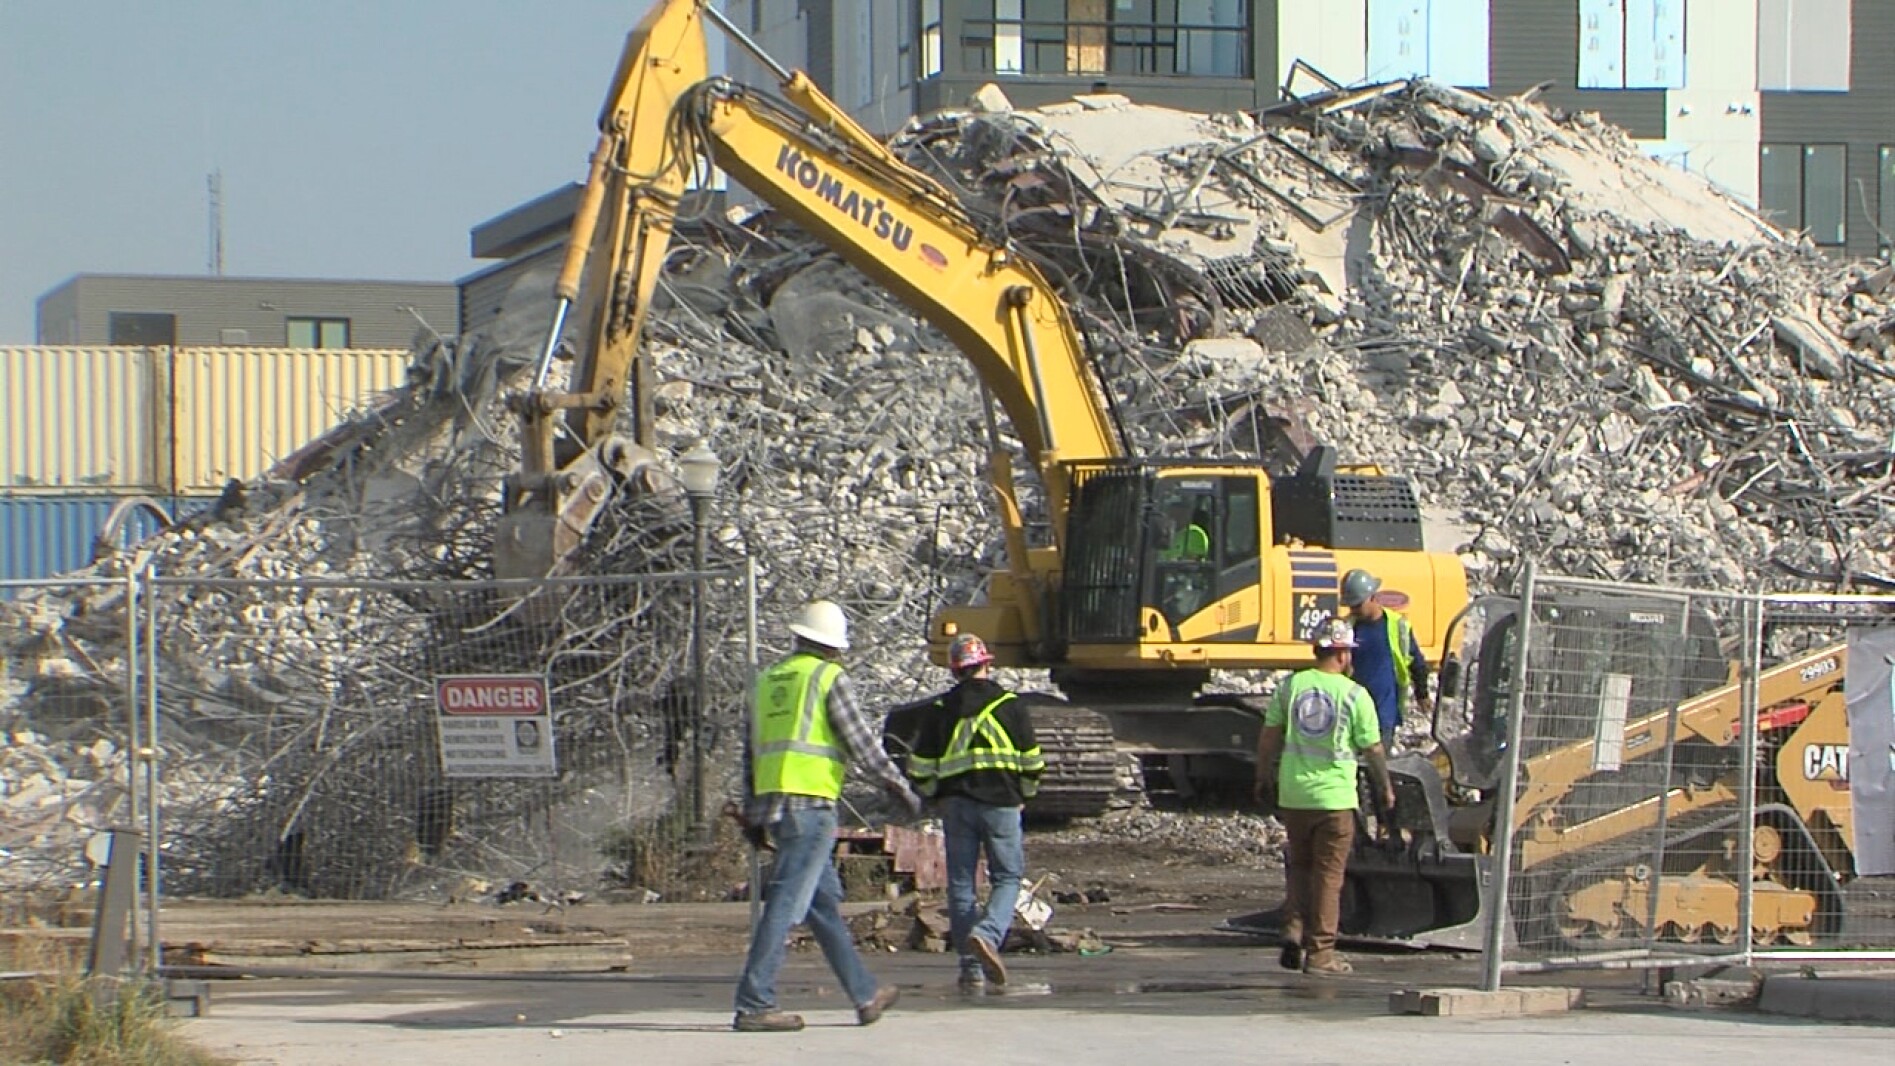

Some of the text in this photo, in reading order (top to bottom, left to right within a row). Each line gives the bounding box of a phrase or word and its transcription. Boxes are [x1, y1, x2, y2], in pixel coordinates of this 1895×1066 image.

[776, 144, 912, 251] KOMATSU
[1300, 594, 1317, 608] PC
[448, 686, 539, 707] DANGER
[1804, 745, 1850, 780] CAT
